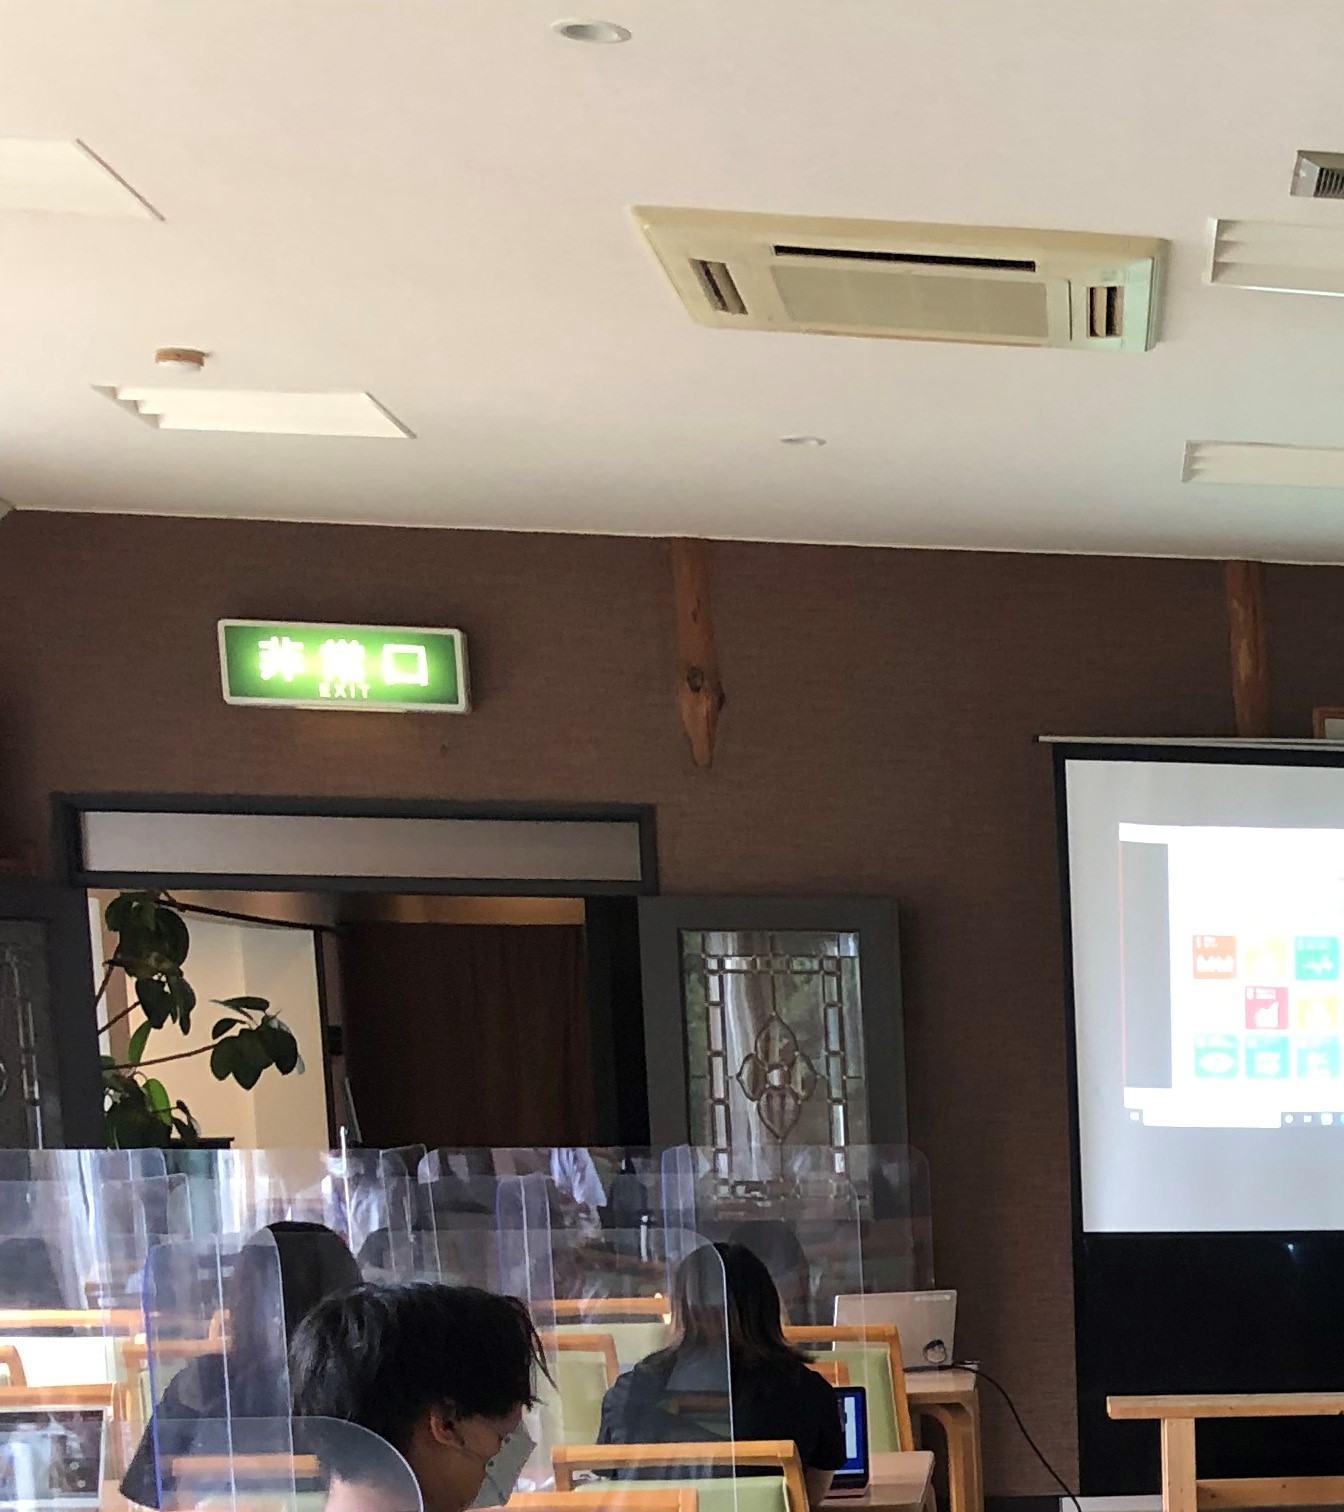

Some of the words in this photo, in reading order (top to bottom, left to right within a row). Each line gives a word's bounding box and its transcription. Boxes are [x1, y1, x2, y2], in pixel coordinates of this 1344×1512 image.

[257, 635, 429, 687] 非常口
[318, 681, 372, 699] EXIT
